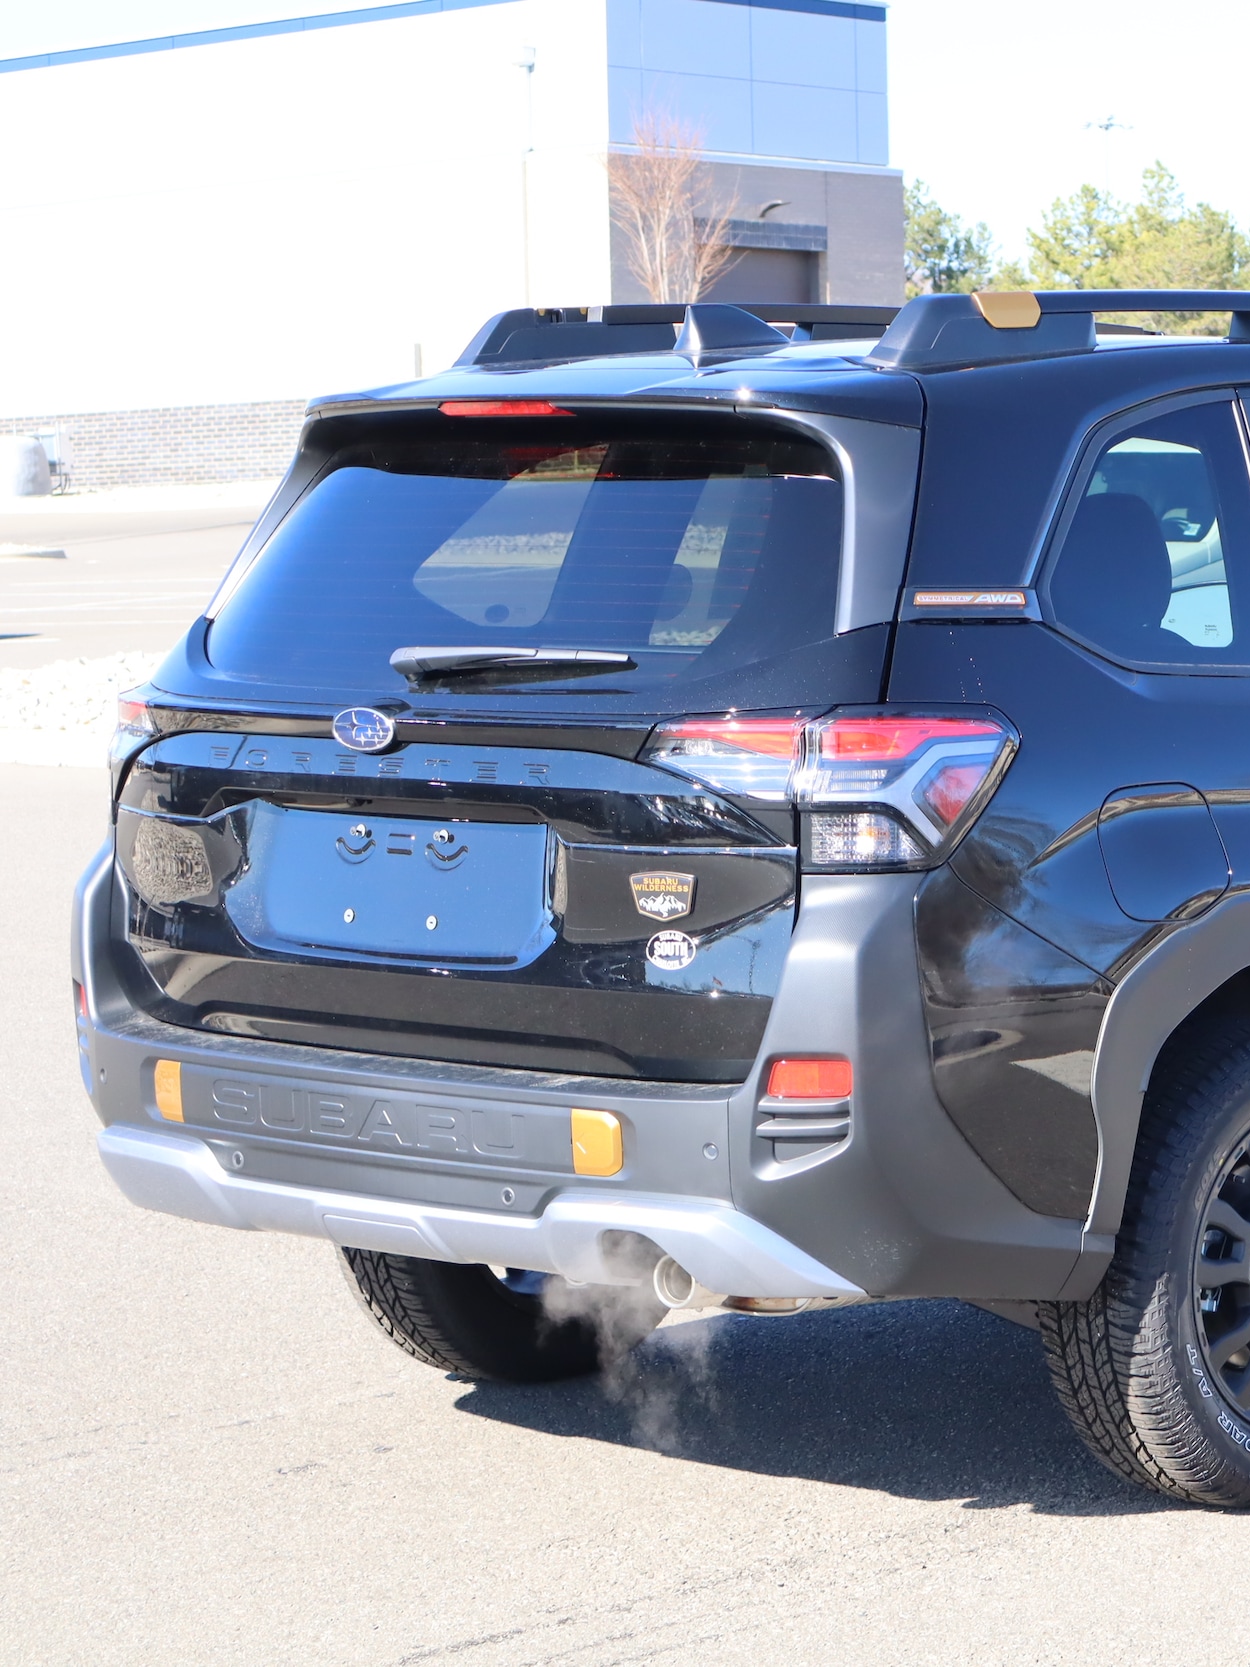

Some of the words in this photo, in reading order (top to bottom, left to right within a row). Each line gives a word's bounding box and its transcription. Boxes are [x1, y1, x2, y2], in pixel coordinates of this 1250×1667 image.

[975, 593, 1022, 603] AWD
[208, 746, 551, 785] FORESTER
[634, 883, 689, 893] WILDERNESS
[643, 877, 679, 886] SUBARU
[654, 941, 688, 957] SOUTH
[212, 1078, 525, 1159] SUBARU
[1186, 1343, 1213, 1398] A/T
